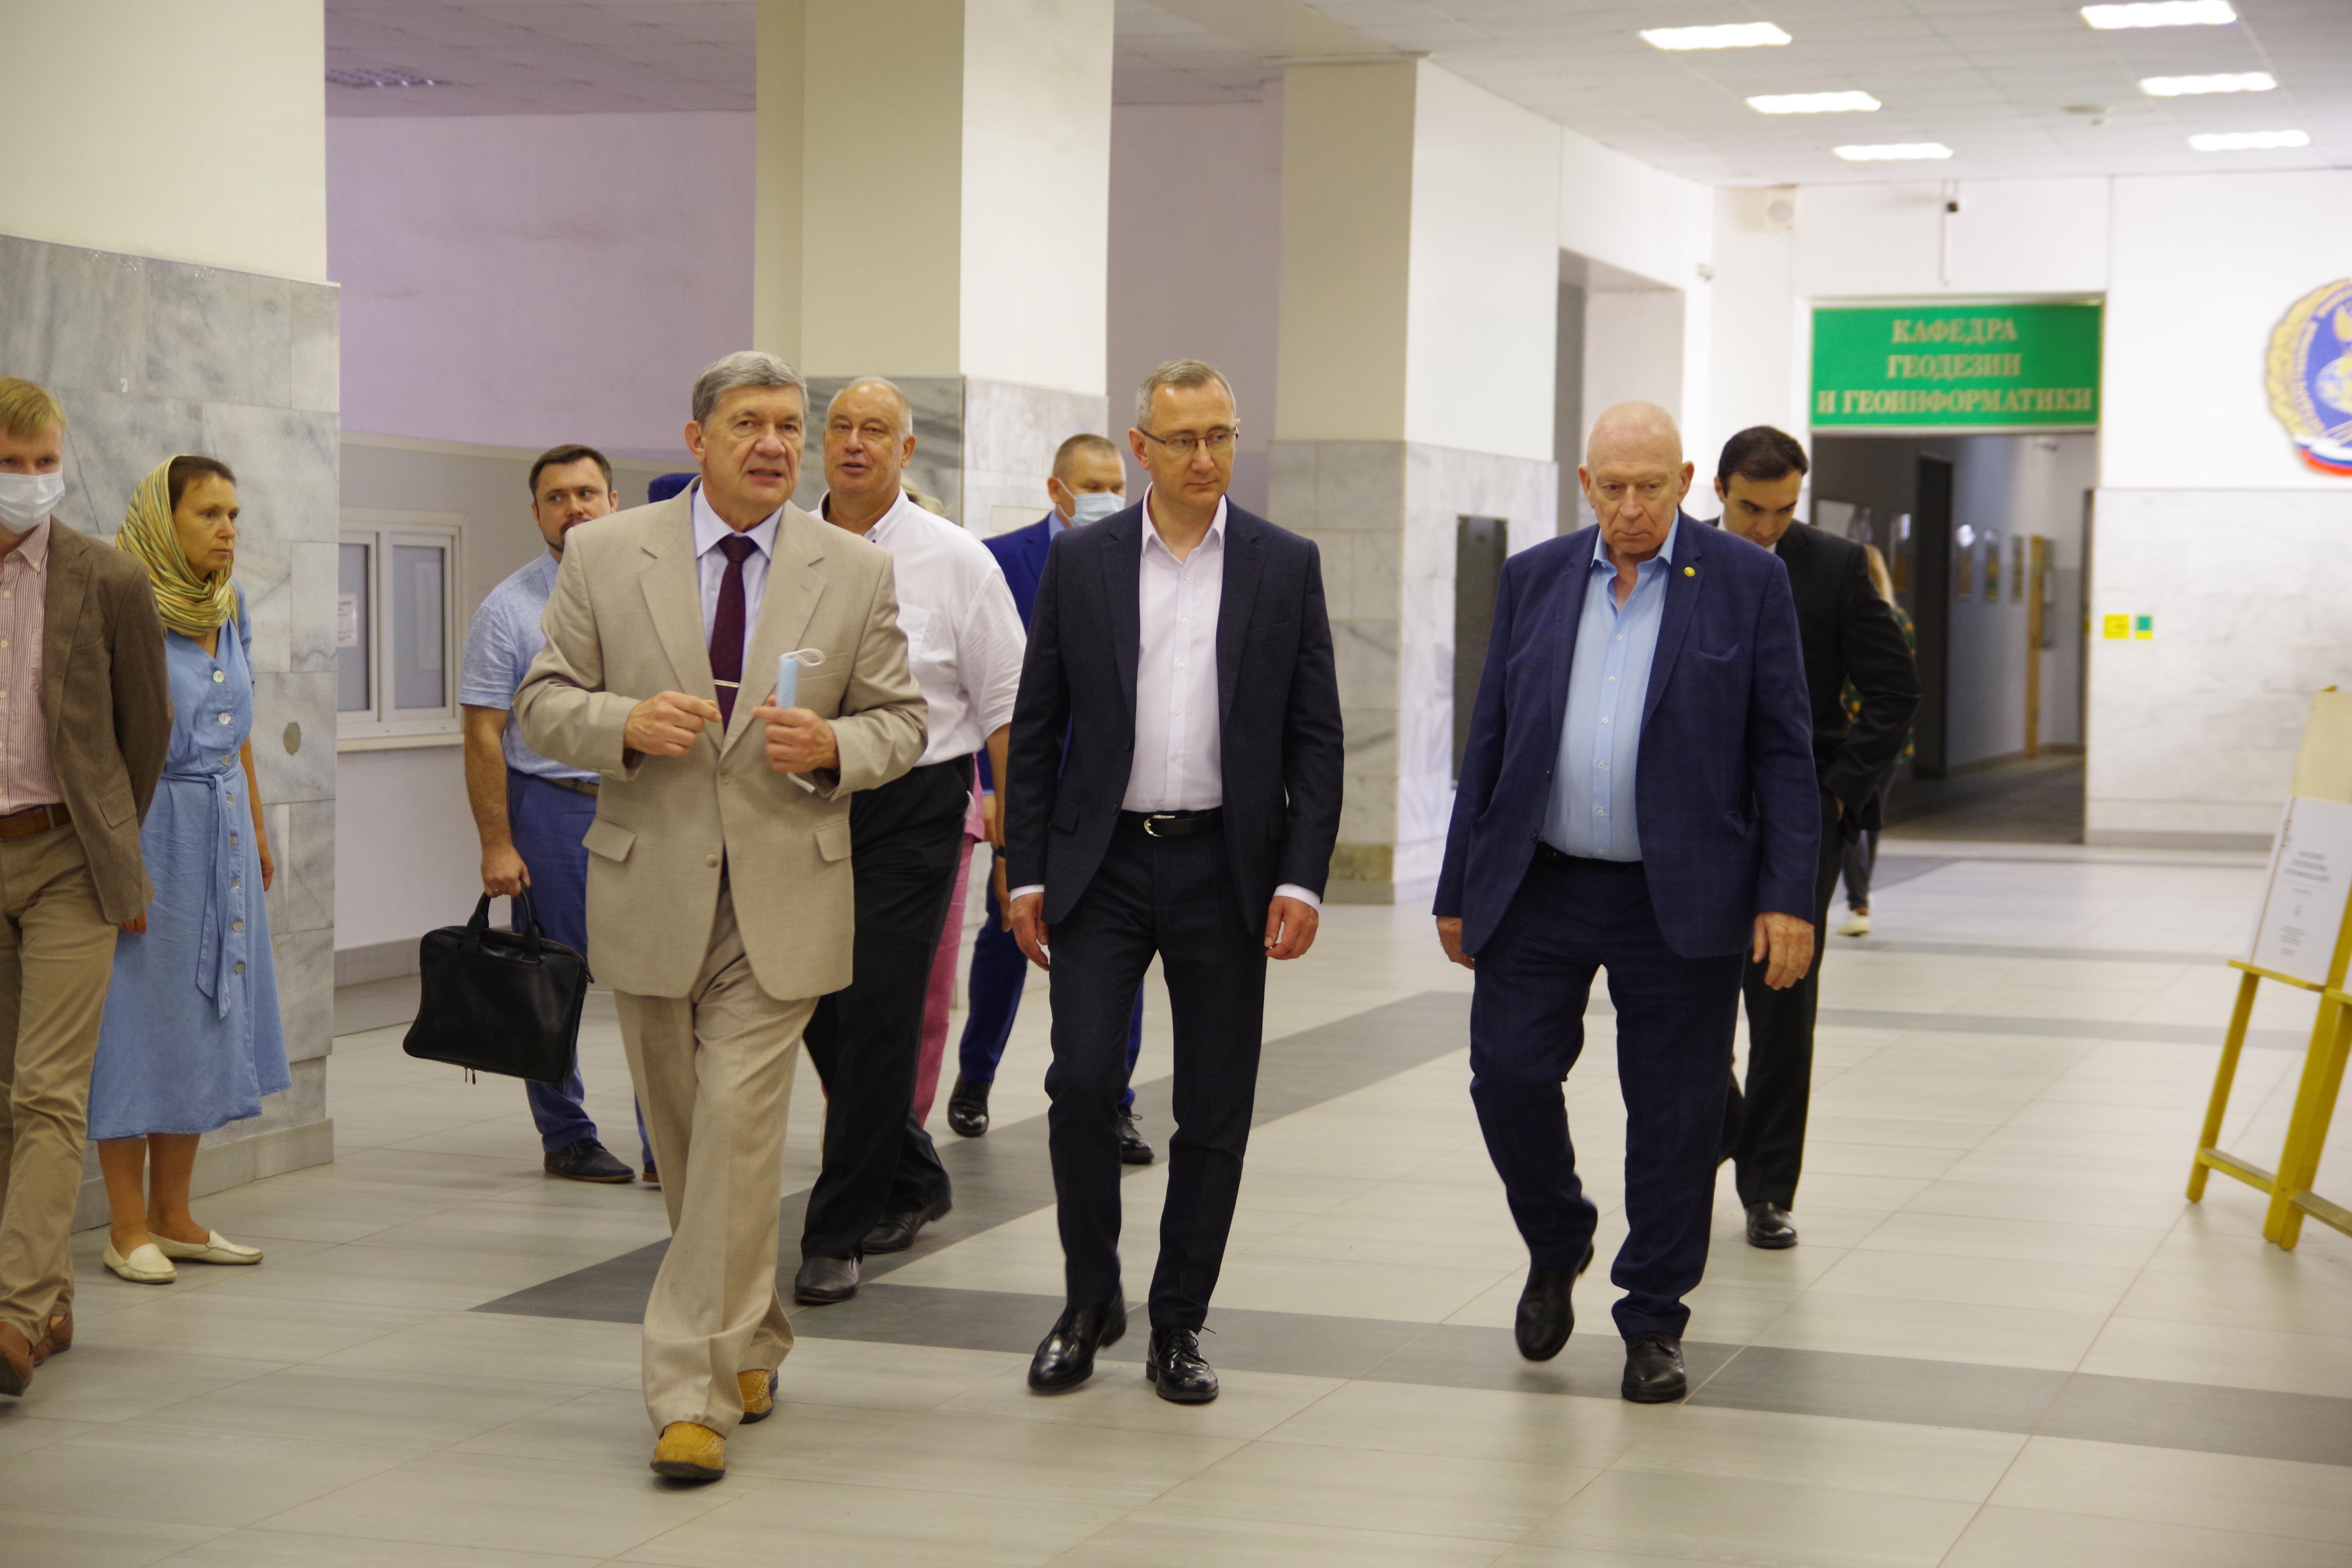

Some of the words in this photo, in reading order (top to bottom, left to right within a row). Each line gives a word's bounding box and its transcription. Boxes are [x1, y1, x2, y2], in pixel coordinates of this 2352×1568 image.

[1891, 318, 2018, 345] КАФЕДРА
[1886, 353, 2022, 381] ГЕОДЕЗИИ
[1816, 389, 1837, 414] И
[1841, 387, 2093, 414] ГЕОИНФОРМАТИКИ
